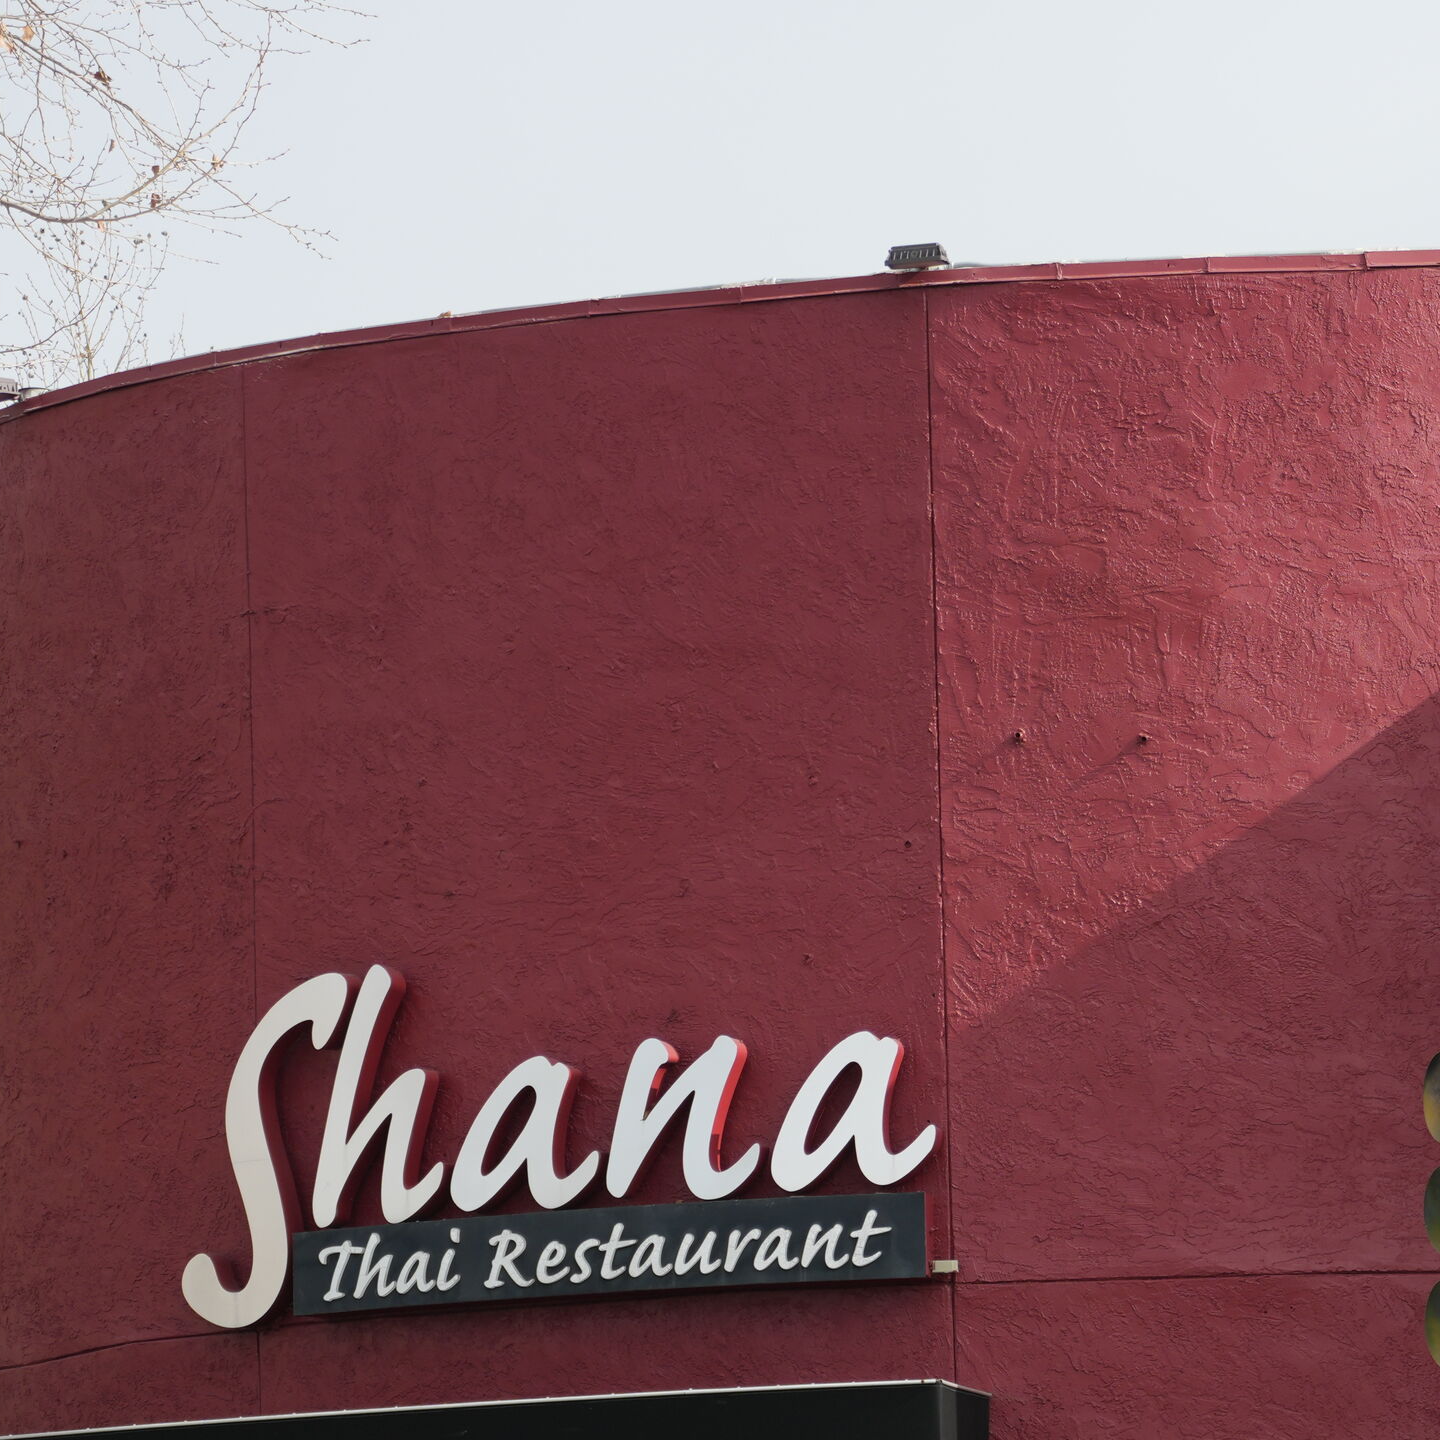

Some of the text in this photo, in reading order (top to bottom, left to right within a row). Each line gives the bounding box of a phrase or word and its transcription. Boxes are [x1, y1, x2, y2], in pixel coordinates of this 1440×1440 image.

[182, 963, 938, 1329] Shana
[317, 1208, 892, 1302] Thai Restaurant
